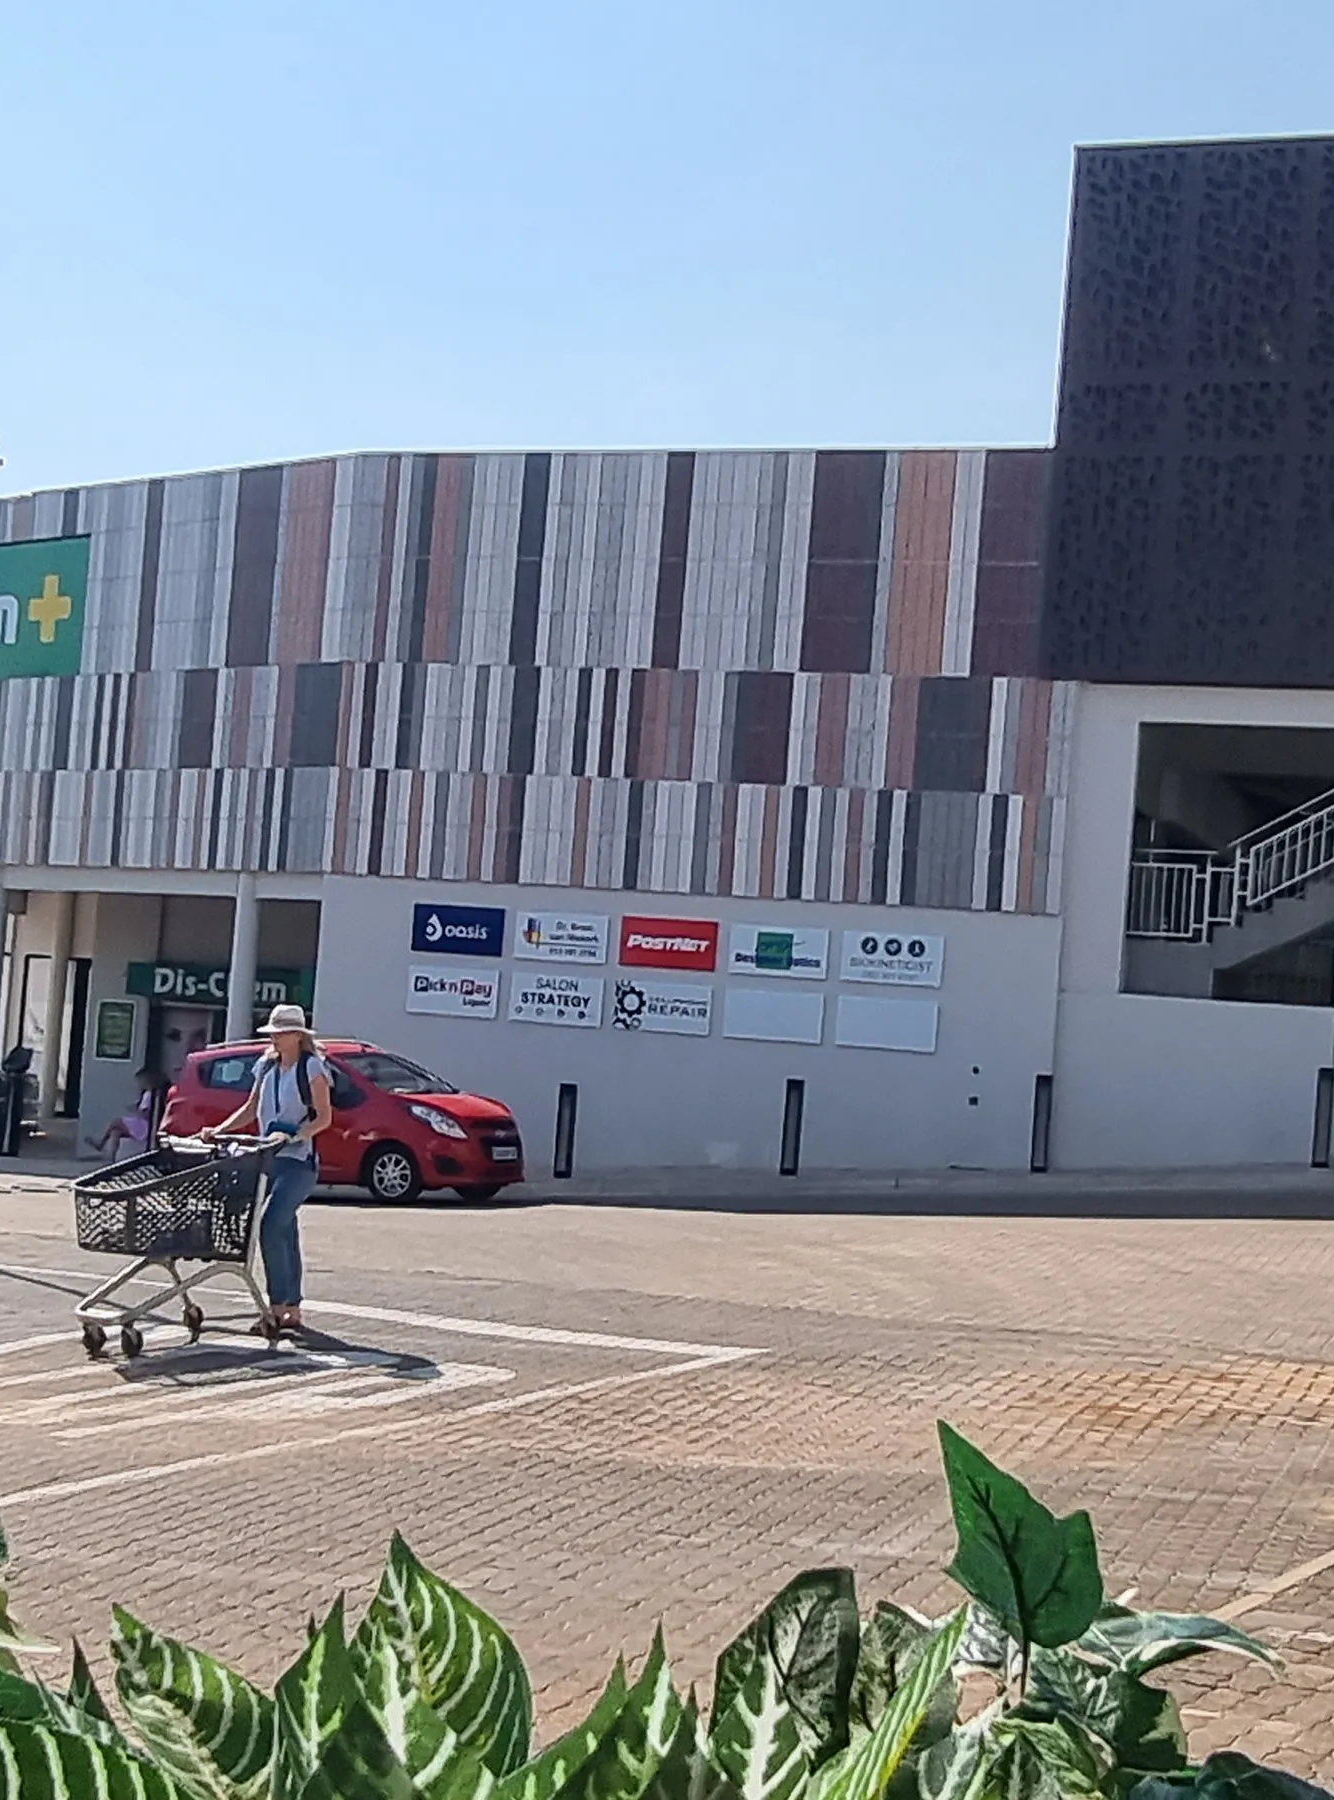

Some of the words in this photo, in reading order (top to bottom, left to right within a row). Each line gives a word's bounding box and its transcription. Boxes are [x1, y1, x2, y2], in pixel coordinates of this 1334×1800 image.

[445, 924, 488, 940] oasis
[154, 967, 287, 1002] Dis-Cm
[535, 977, 579, 992] SALON
[521, 991, 590, 1009] STRATEGY
[647, 1003, 708, 1019] REPAIR
